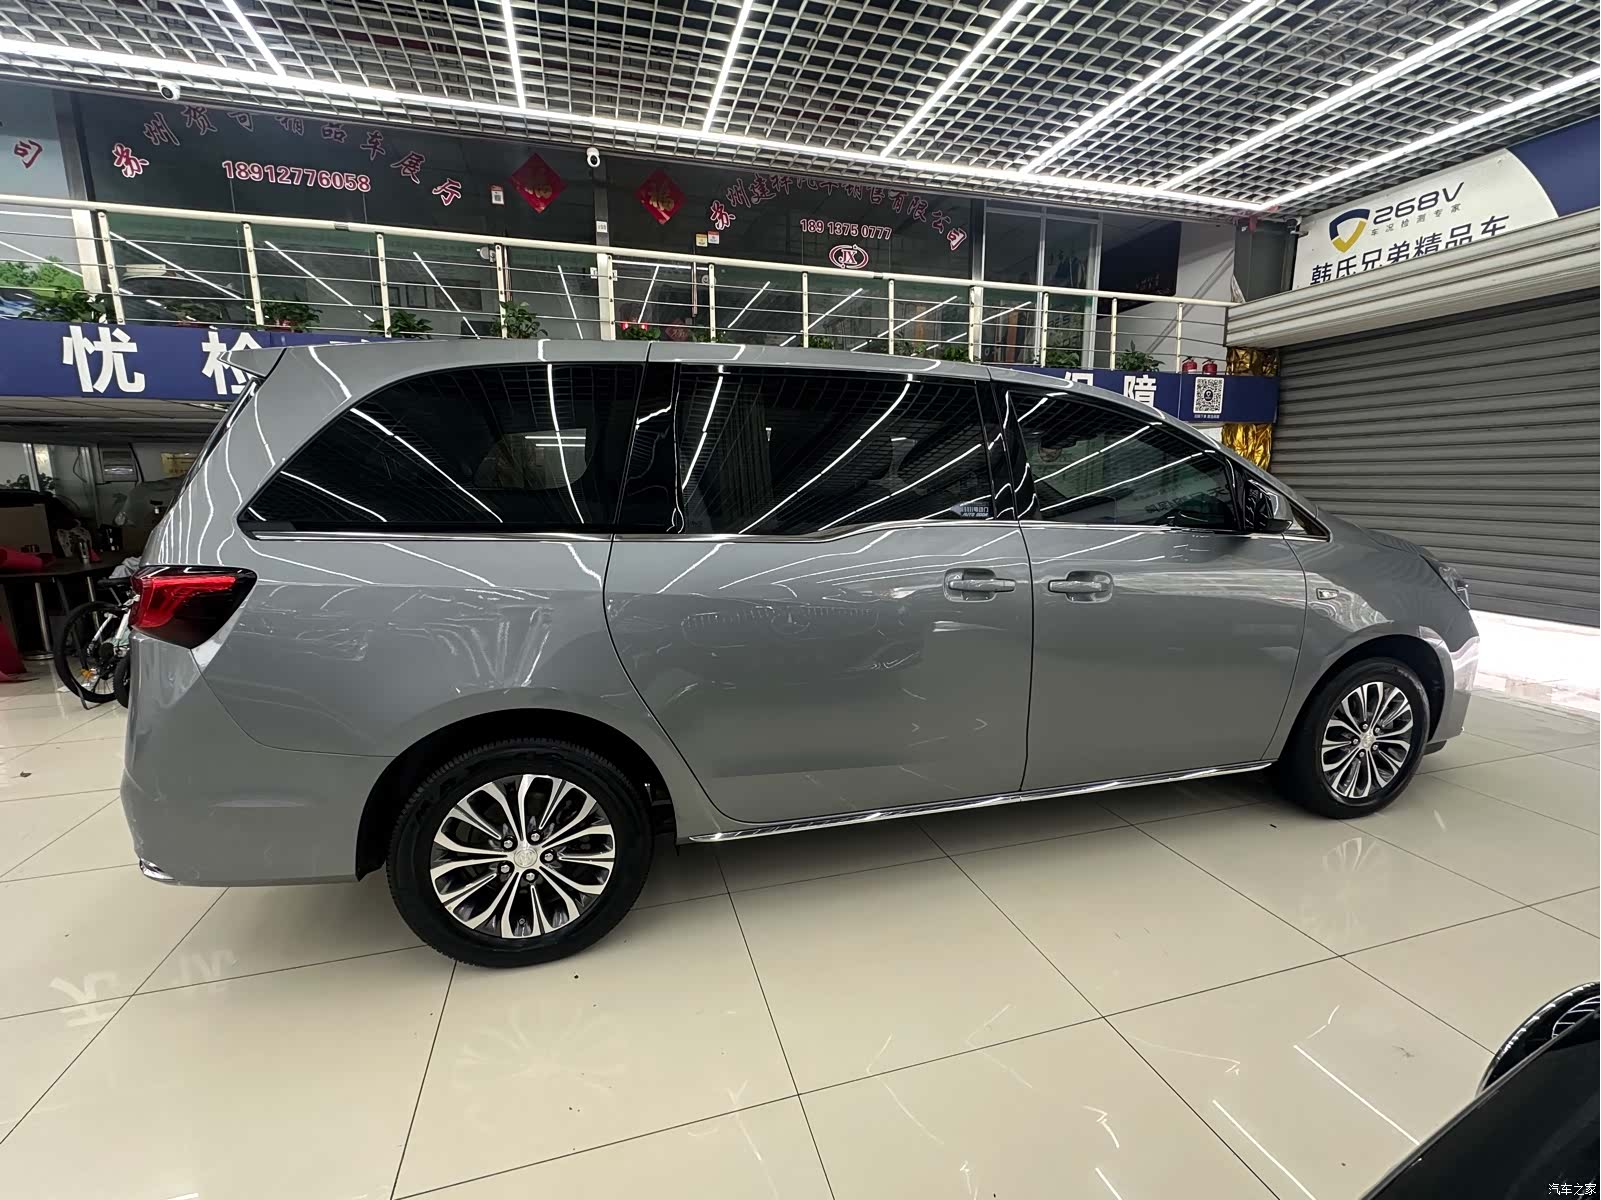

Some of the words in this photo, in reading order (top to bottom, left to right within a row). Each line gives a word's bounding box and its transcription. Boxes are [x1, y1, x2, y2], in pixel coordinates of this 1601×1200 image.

[13, 138, 43, 169] 司
[222, 160, 371, 192] 18912776058
[1373, 181, 1465, 225] 268V
[800, 218, 825, 233] 189
[827, 221, 859, 236] 1375
[861, 225, 893, 239] 0777
[1370, 203, 1462, 236] 车况检测专家
[1310, 215, 1510, 285] 韩氏兄弟精品车
